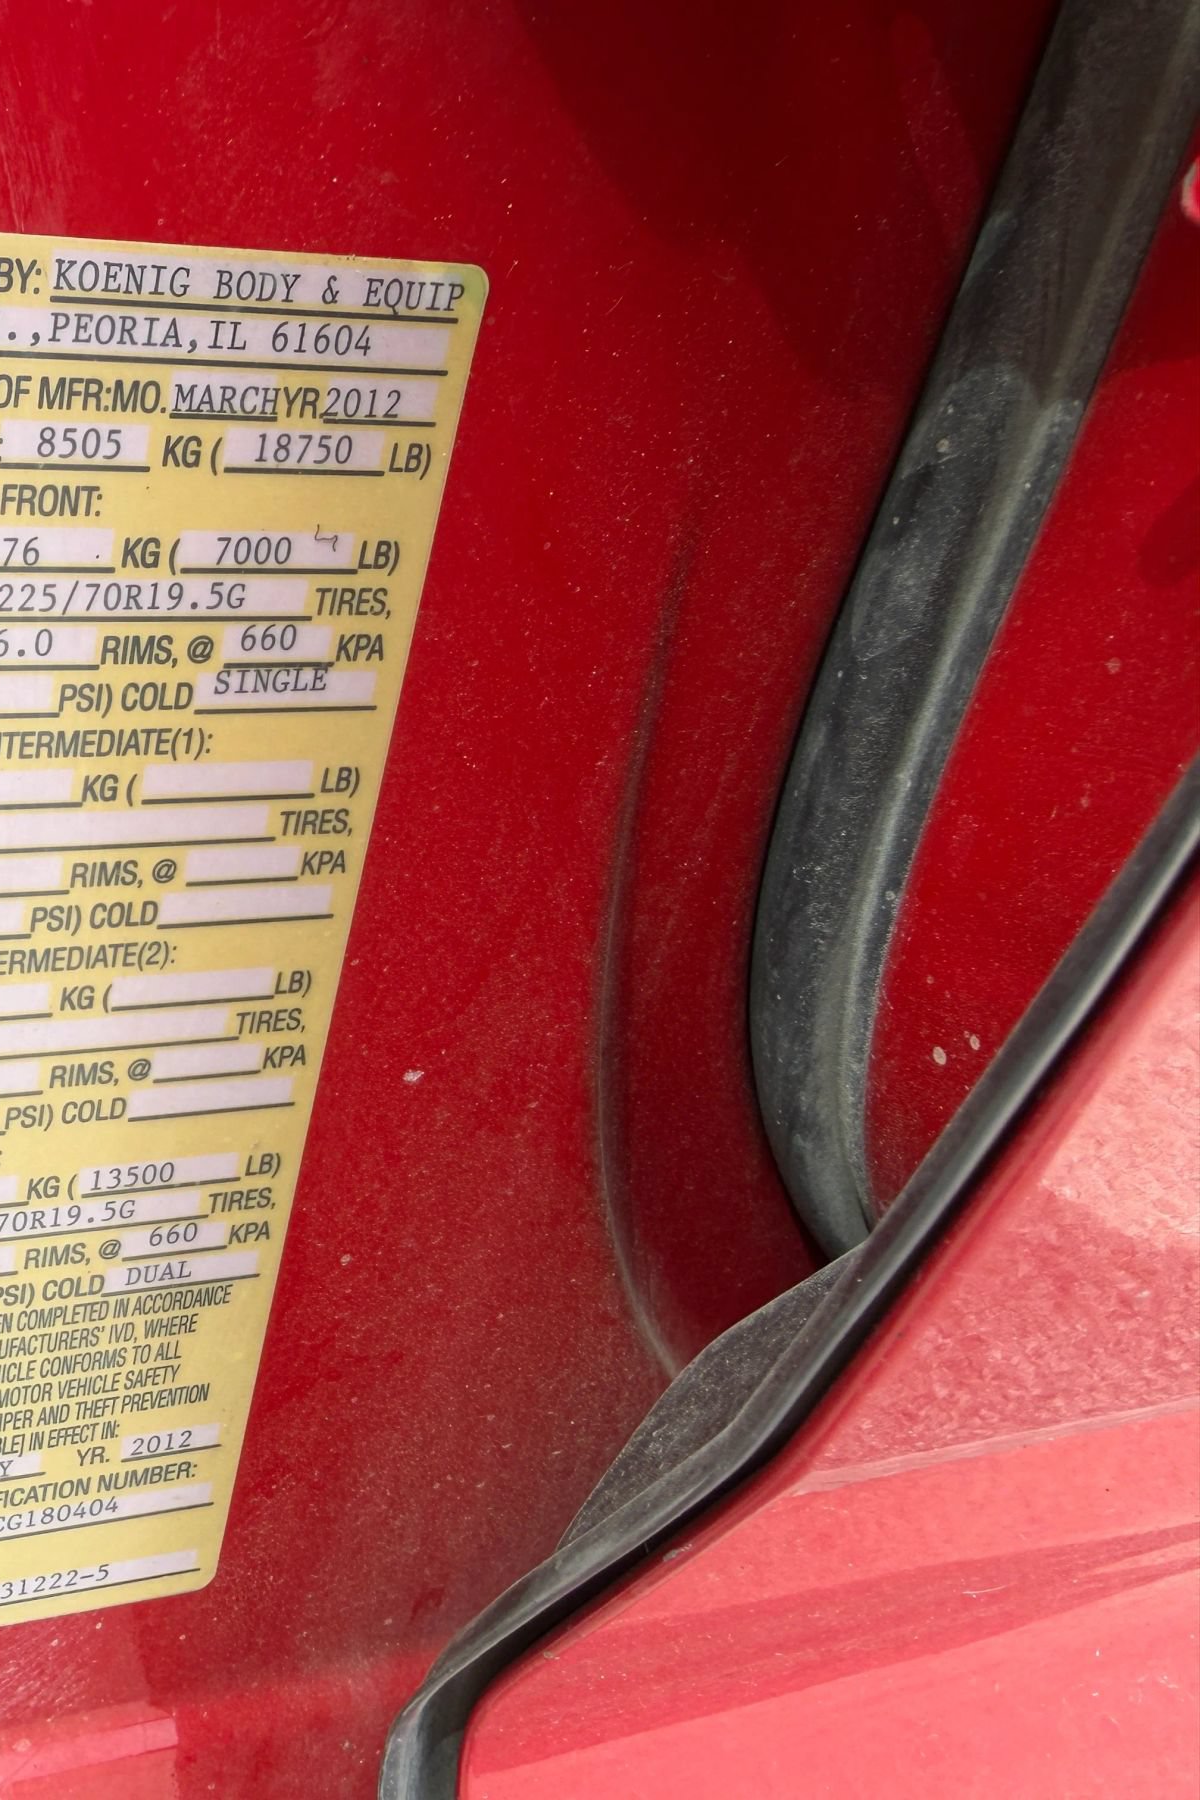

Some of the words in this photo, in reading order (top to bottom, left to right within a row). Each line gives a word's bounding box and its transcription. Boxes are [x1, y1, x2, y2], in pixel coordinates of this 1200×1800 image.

[52, 258, 192, 298] KOENIG
[216, 269, 300, 303] BODY
[321, 275, 340, 304] &
[362, 278, 466, 314] EQUIP
[271, 322, 372, 356] 61604
[174, 382, 279, 416] MARCH
[323, 388, 402, 419] 2012
[37, 428, 122, 459] 8505
[253, 434, 353, 464] 18750
[388, 442, 431, 480] LB)
[216, 536, 292, 566] 7000
[358, 542, 400, 575] LB)
[314, 588, 391, 620] TIRES,
[100, 635, 179, 667] RIMS,
[241, 624, 297, 652] 660
[334, 634, 384, 662] KPA
[59, 683, 112, 717] PSI)
[121, 682, 193, 712] COLD
[214, 668, 329, 695] SINGLE
[320, 765, 360, 796] LB)
[280, 807, 353, 837] TIRES,
[70, 860, 144, 889] RIMS,
[301, 849, 346, 875] KPA
[30, 904, 81, 937] PSI)
[89, 900, 158, 929] COLD
[273, 970, 312, 999] LB)
[236, 1008, 306, 1036] TIRES,
[49, 1062, 120, 1088] RIMS,
[262, 1044, 306, 1069] KPA
[4, 1102, 54, 1131] PSI)
[61, 1097, 126, 1124] COLD
[89, 1162, 175, 1192] 13500
[245, 1152, 280, 1178] LB)
[209, 1188, 276, 1214] TIRES,
[24, 1242, 91, 1270] RIMS,
[148, 1222, 198, 1247] 660
[228, 1221, 270, 1245] KPA
[41, 1274, 105, 1300] COLD
[125, 1261, 192, 1286] DUAL
[16, 1298, 109, 1332] COMPLETED
[113, 1297, 128, 1319] IN
[131, 1284, 232, 1317] ACCORDANCE
[109, 1322, 138, 1346] IVD,
[144, 1314, 198, 1338] WHERE
[39, 1348, 127, 1379] CONFORMS
[131, 1343, 150, 1362] TO
[154, 1338, 182, 1361] ALL
[57, 1372, 121, 1402] VEHICLE
[123, 1364, 181, 1390] SAFETY
[37, 1402, 70, 1427] AND
[75, 1394, 118, 1419] THEFT
[121, 1383, 210, 1414] PREVENTION
[29, 1430, 44, 1451] IN
[48, 1419, 98, 1446] EFFECT
[101, 1420, 119, 1441] IN:
[77, 1447, 110, 1468] YR.
[130, 1430, 193, 1457] 2012
[99, 1460, 198, 1492] NUMBER:
